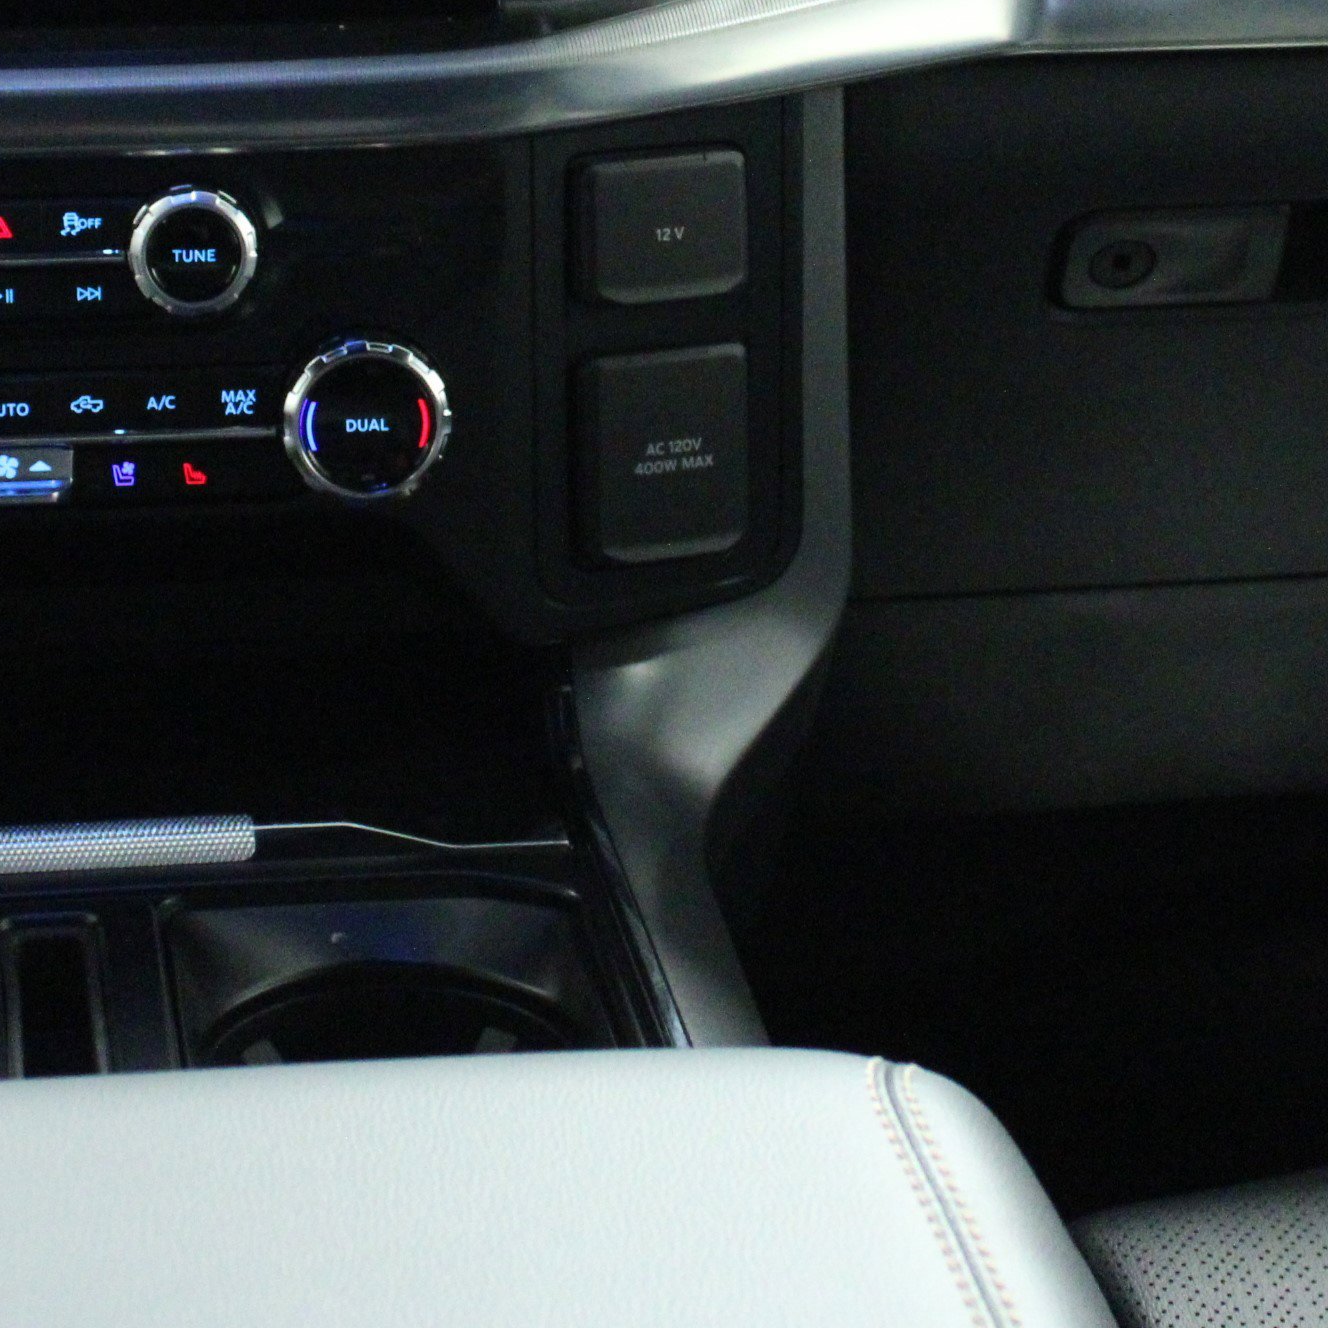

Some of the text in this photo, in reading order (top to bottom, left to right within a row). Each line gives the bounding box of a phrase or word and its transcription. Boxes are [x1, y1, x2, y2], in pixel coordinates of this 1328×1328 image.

[77, 215, 102, 229] OFF
[172, 248, 216, 263] TUNE
[146, 395, 176, 411] A/C
[221, 389, 257, 403] MAX
[225, 401, 254, 416] A/C
[346, 418, 389, 433] DUAL
[646, 437, 703, 457] AC 120V
[635, 453, 714, 476] 400W MAX
